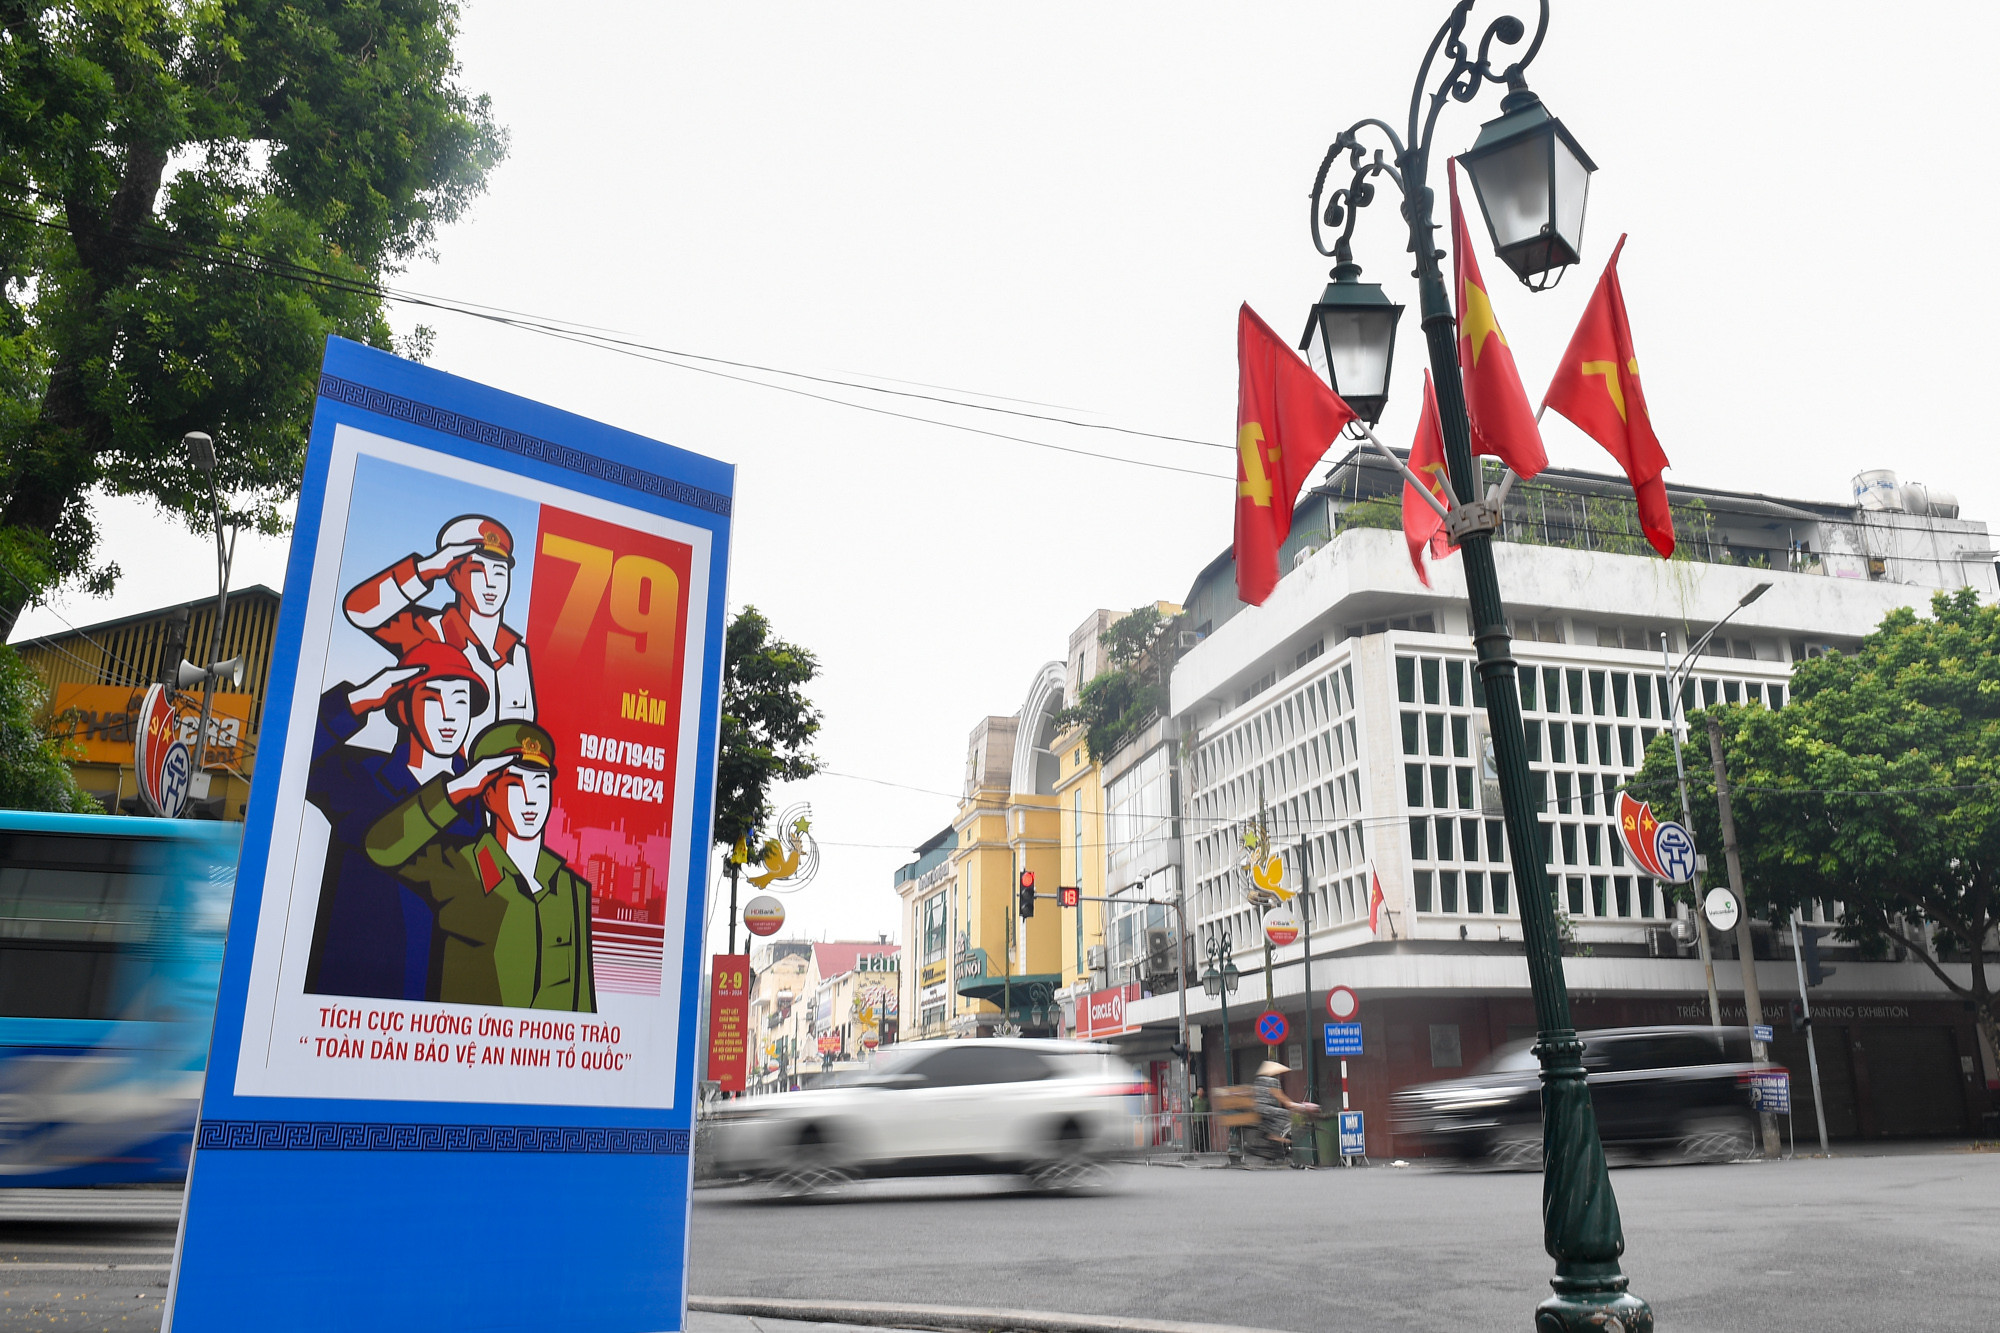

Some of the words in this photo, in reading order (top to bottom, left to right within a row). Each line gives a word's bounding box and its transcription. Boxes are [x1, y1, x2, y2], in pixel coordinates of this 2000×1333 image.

[542, 532, 679, 690] 79
[621, 688, 666, 726] NĂM
[580, 733, 665, 771] 19/8/1945
[576, 766, 664, 804] 19/8/2024
[966, 959, 981, 978] NỘI
[319, 1003, 362, 1029] TÍCH
[368, 1010, 404, 1035] CỰC
[410, 1009, 473, 1035] HƯỞNG
[478, 1013, 514, 1038] ỨNG
[519, 1020, 576, 1041] PHONG
[580, 1021, 621, 1044] TRÀO
[1092, 1002, 1111, 1020] CIRCLE
[1112, 997, 1120, 1020] K
[1810, 1006, 1854, 1018] PAINTING
[1858, 1006, 1909, 1018] EXHIBITION
[315, 1033, 364, 1059] TOÀN
[370, 1037, 408, 1061] DÂN
[414, 1038, 449, 1063] BẢO
[456, 1041, 477, 1068] VỆ
[481, 1046, 505, 1065] AN
[510, 1047, 550, 1067] NINH
[556, 1042, 576, 1069] TỔ
[1357, 1133, 1363, 1147] XE
